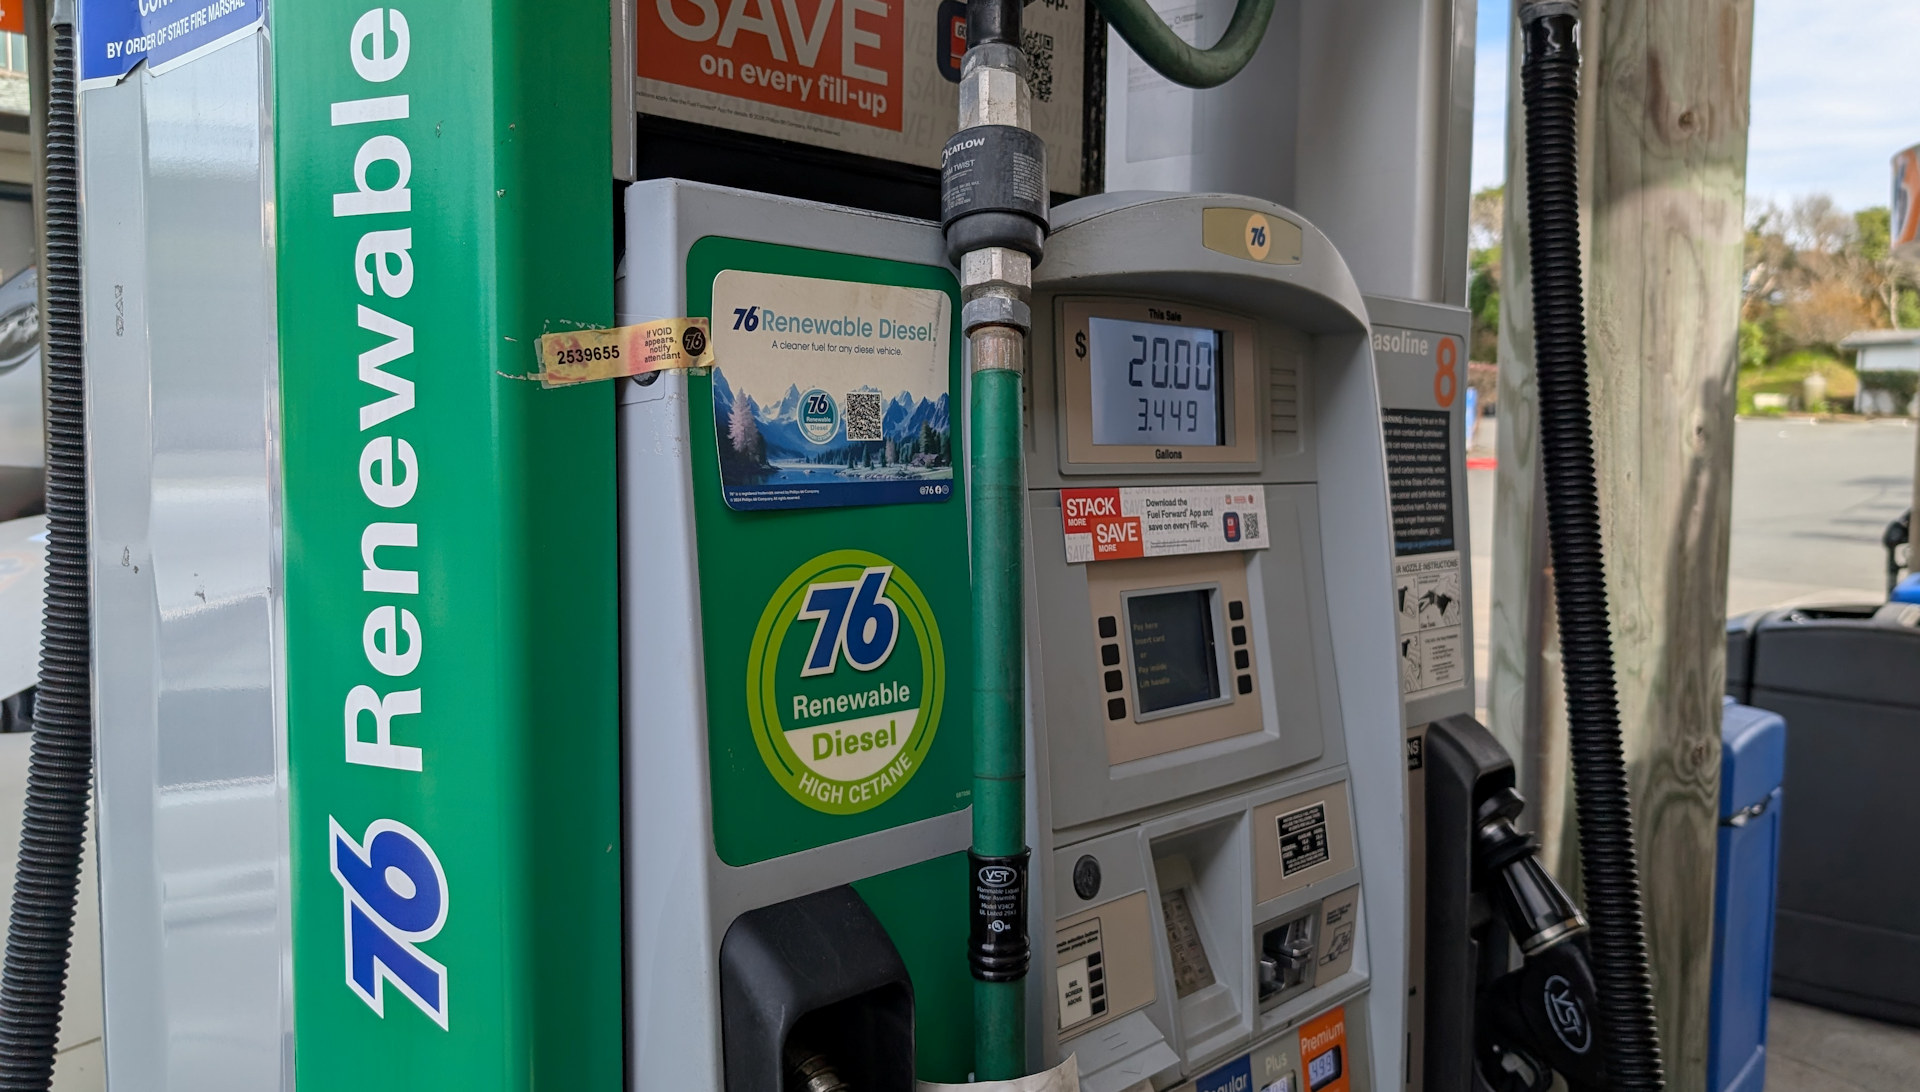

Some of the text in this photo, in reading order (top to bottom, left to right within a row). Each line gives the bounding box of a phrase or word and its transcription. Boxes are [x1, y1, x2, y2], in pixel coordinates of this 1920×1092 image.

[107, 41, 123, 58] BY
[126, 34, 156, 55] ORDER
[157, 30, 167, 44] OF
[168, 17, 189, 41] STATE
[191, 8, 207, 33] FIRE
[656, 0, 888, 86] SAVE
[700, 54, 887, 118] on every fill-up
[948, 138, 985, 156] CATLOW
[954, 160, 975, 173] TWIST
[1251, 226, 1266, 247] 76
[733, 306, 936, 342] 76 Renewable Diesel.
[1149, 308, 1181, 322] This Sale
[645, 337, 677, 347] appears,
[646, 327, 672, 338] If VOID
[685, 329, 703, 350] 76
[650, 345, 671, 354] notify
[780, 342, 809, 350] cleaner
[811, 343, 826, 352] fuel
[827, 344, 837, 352] for
[839, 346, 852, 355] any
[855, 345, 875, 354] diesel
[877, 346, 902, 356] vehicle.
[1075, 330, 1086, 361] $
[1371, 331, 1428, 356] asoline
[557, 345, 620, 364] 2539655
[645, 352, 680, 363] attendant
[1129, 335, 1211, 390] 20.00
[1434, 336, 1457, 409] 8
[331, 7, 422, 774] Renewable
[808, 393, 829, 414] 76
[1138, 398, 1198, 432] 3.449
[1155, 449, 1182, 460] Gallons
[920, 486, 934, 495] @76
[1067, 497, 1116, 516] STACK
[1146, 498, 1187, 507] Download the
[1068, 518, 1087, 526] MORE
[1147, 510, 1160, 519] Fuel
[1190, 508, 1201, 518] App
[1203, 508, 1213, 516] and
[1096, 522, 1138, 544] SAVE
[1190, 520, 1208, 530] fill-up.
[1099, 544, 1117, 552] MORE
[1402, 564, 1421, 573] NOZZLE
[1423, 559, 1458, 570] INSTRUCTIONS
[797, 566, 899, 677] 76
[1133, 624, 1144, 632] Pay
[793, 681, 910, 719] Renewable
[812, 720, 897, 761] Diesel
[799, 752, 912, 804] HIGH CETANE
[986, 869, 1009, 882] VST
[977, 886, 1004, 894] Flammable
[329, 815, 450, 1032] 76
[1550, 989, 1582, 1038] VST
[1301, 1022, 1344, 1055] Premium
[1266, 1053, 1287, 1076] Plus
[1203, 1073, 1248, 1092] gular
